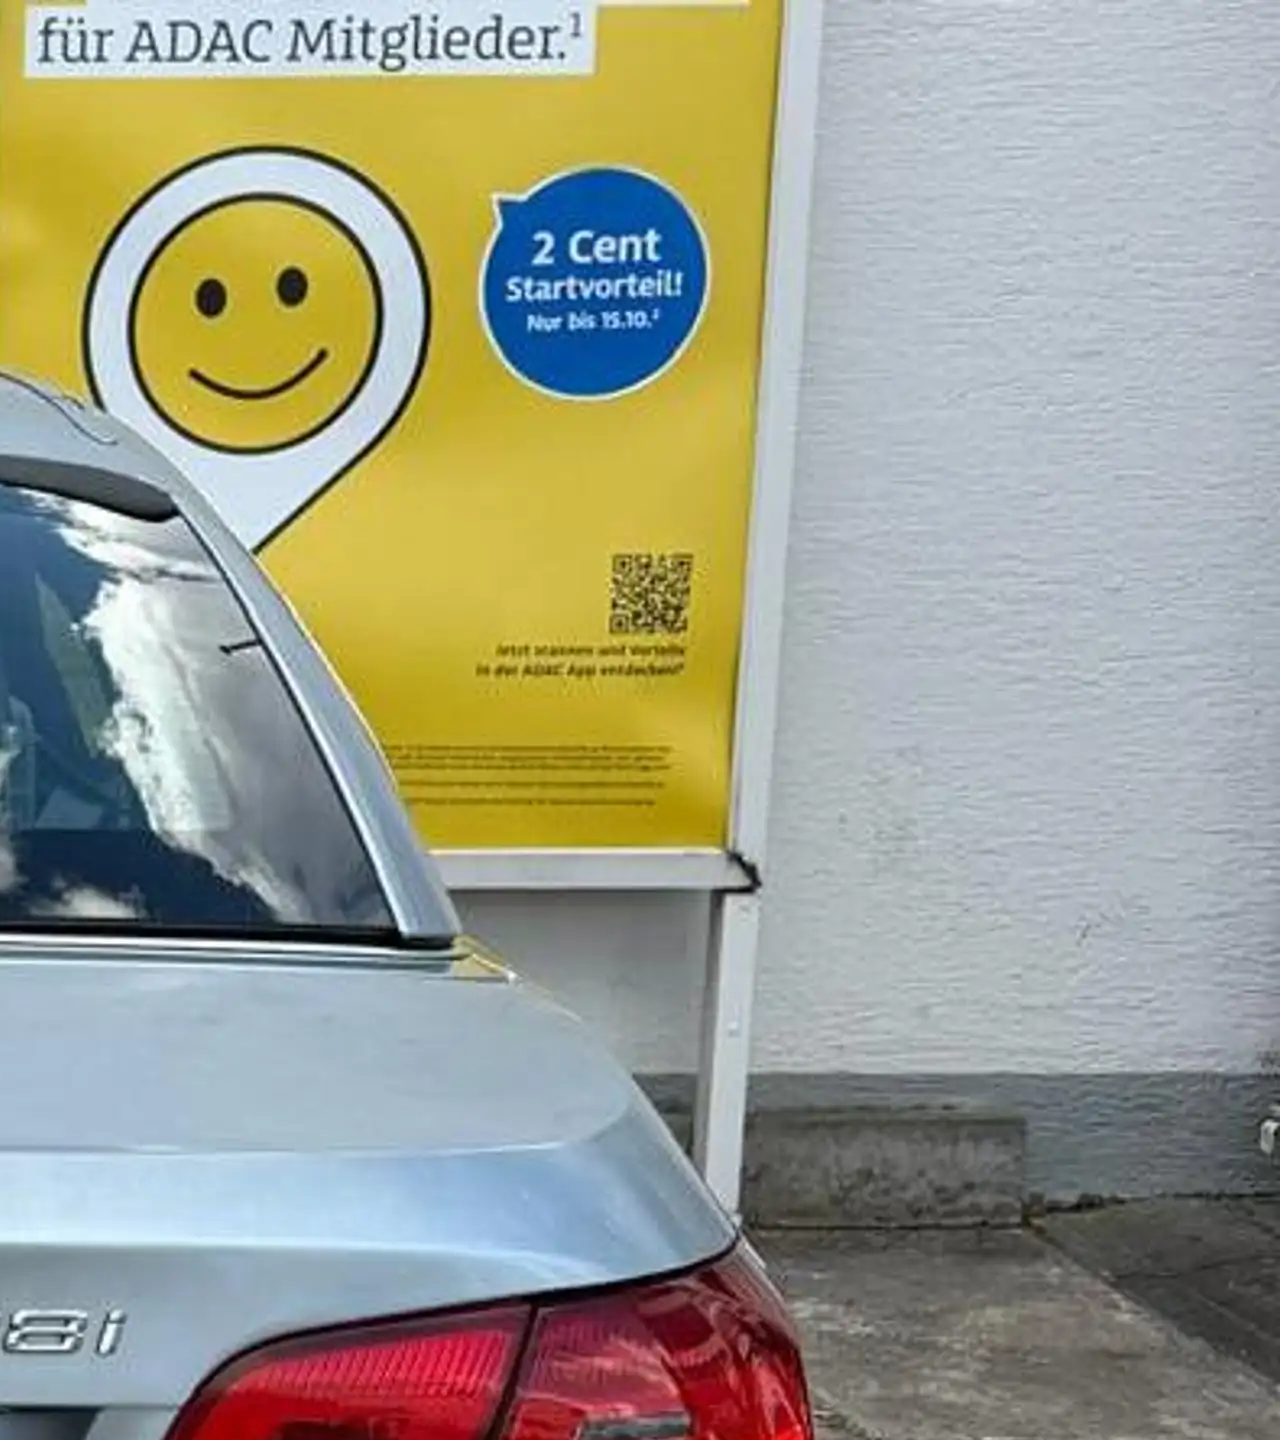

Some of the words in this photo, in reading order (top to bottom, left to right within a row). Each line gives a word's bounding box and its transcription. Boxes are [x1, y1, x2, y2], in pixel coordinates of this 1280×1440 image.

[38, 16, 113, 63] für
[126, 18, 272, 64] ADAC
[531, 230, 556, 266] 2
[568, 228, 663, 264] Cent
[505, 269, 684, 303] Startvorteil!
[527, 314, 562, 333] Nur
[568, 311, 597, 331] bis
[599, 644, 627, 656] und
[522, 664, 562, 677] ADAC
[567, 664, 596, 680] App
